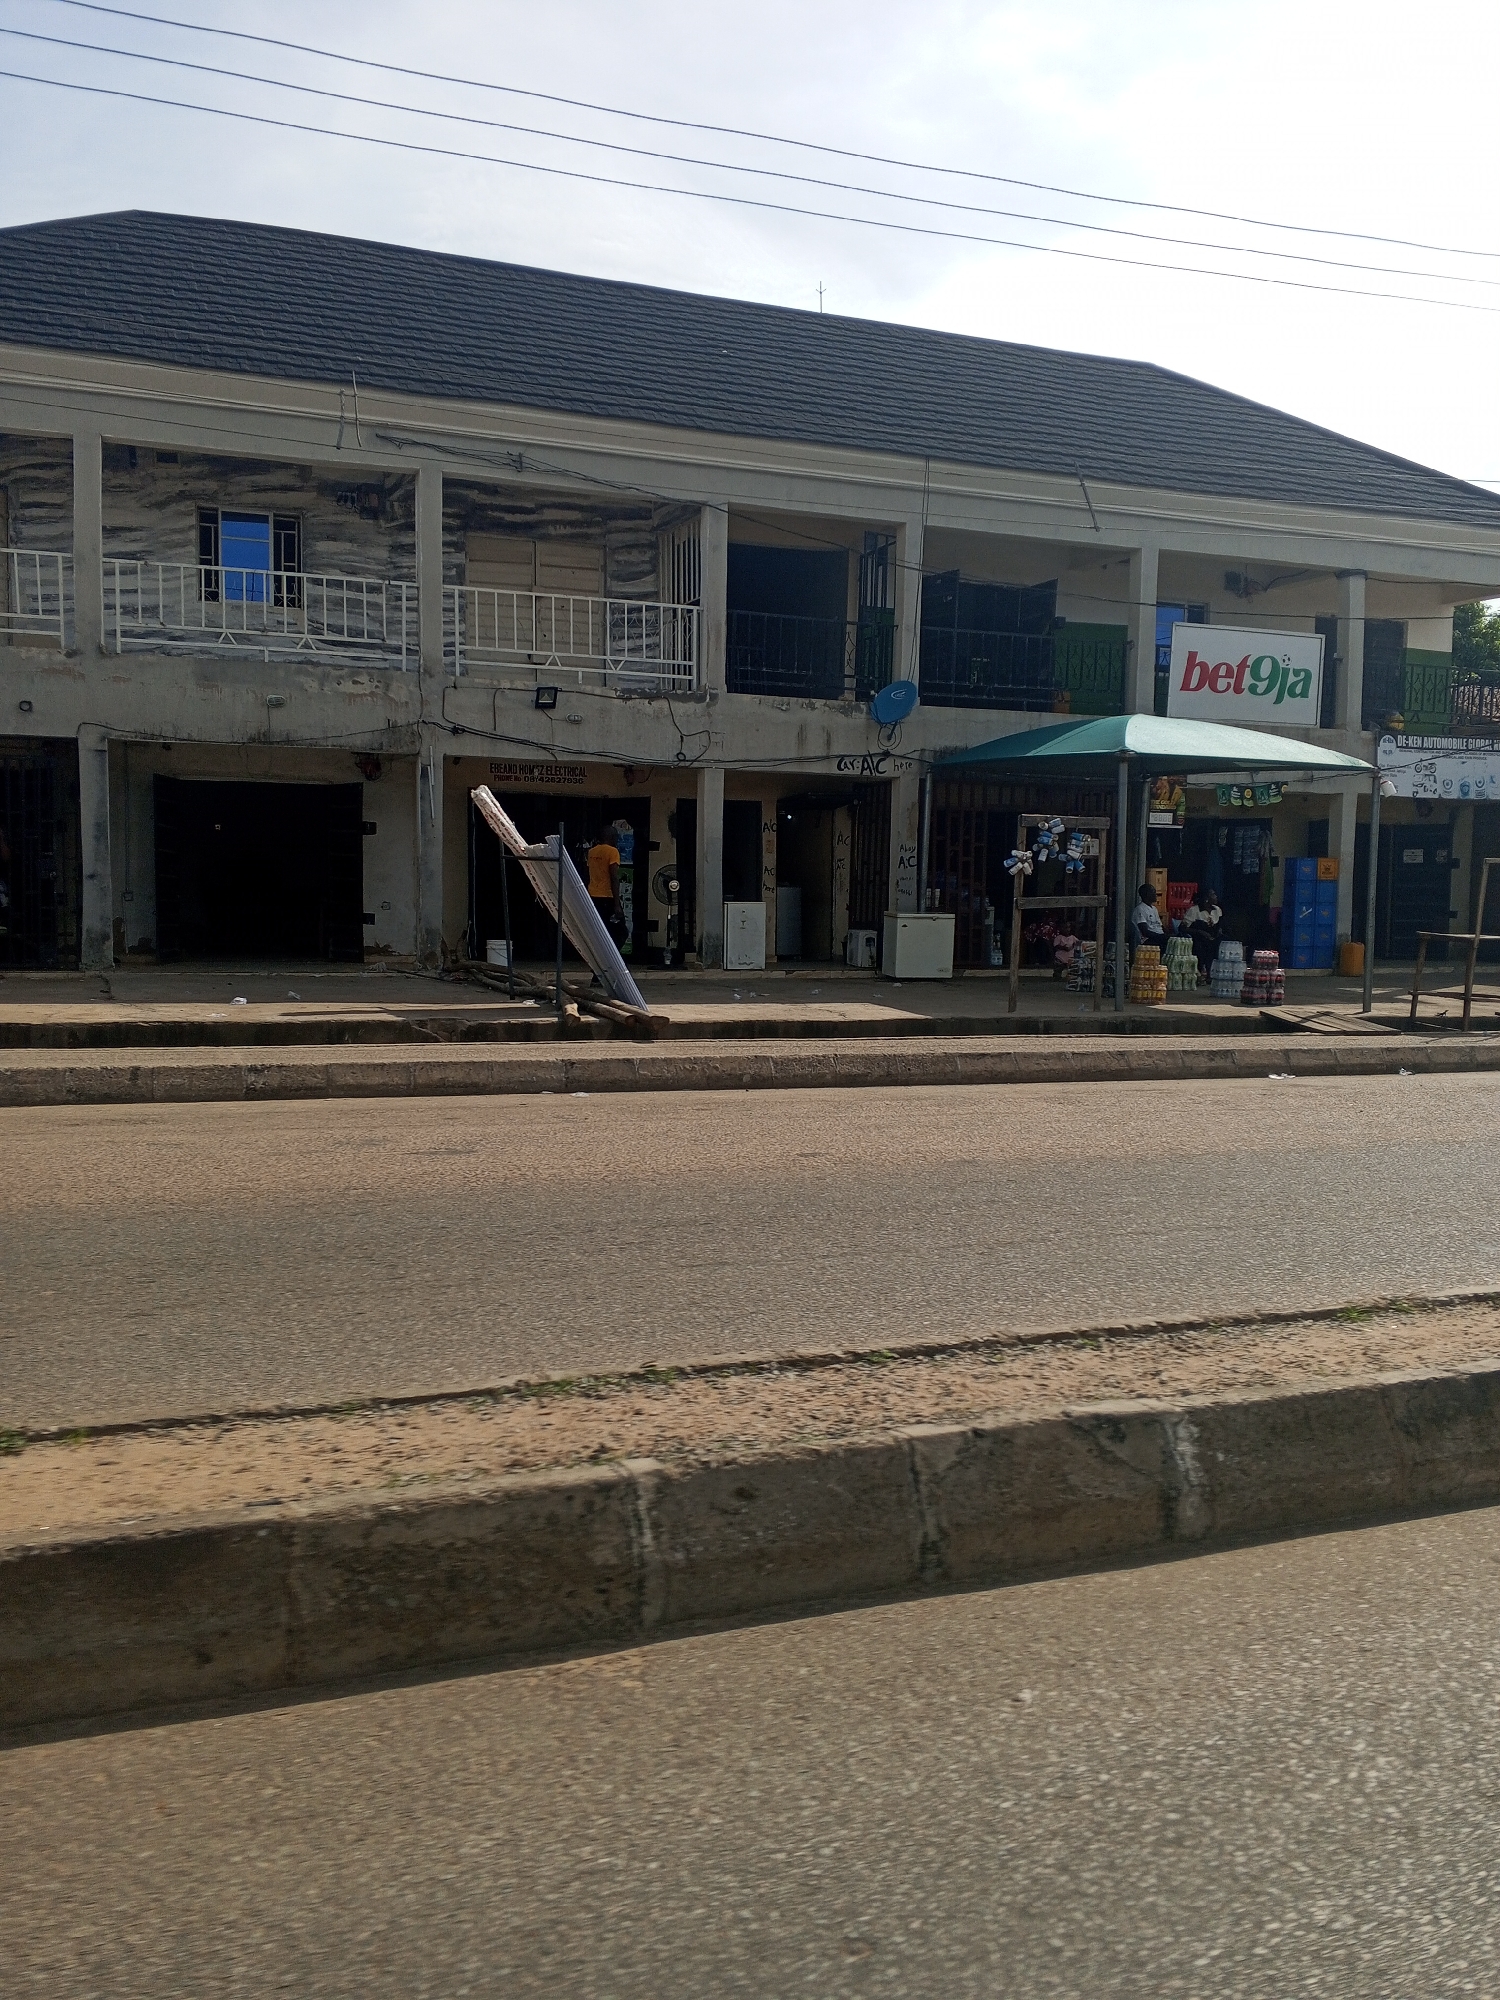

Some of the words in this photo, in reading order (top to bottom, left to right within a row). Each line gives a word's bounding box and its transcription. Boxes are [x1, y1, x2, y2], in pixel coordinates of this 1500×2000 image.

[1180, 651, 1313, 705] bet9ja
[1397, 734, 1422, 748] DE-KEN
[1423, 736, 1467, 750] AUTOMOBILE
[1468, 738, 1493, 751] GLOBAL
[545, 765, 587, 777] ELECTRICAL
[893, 759, 913, 772] here
